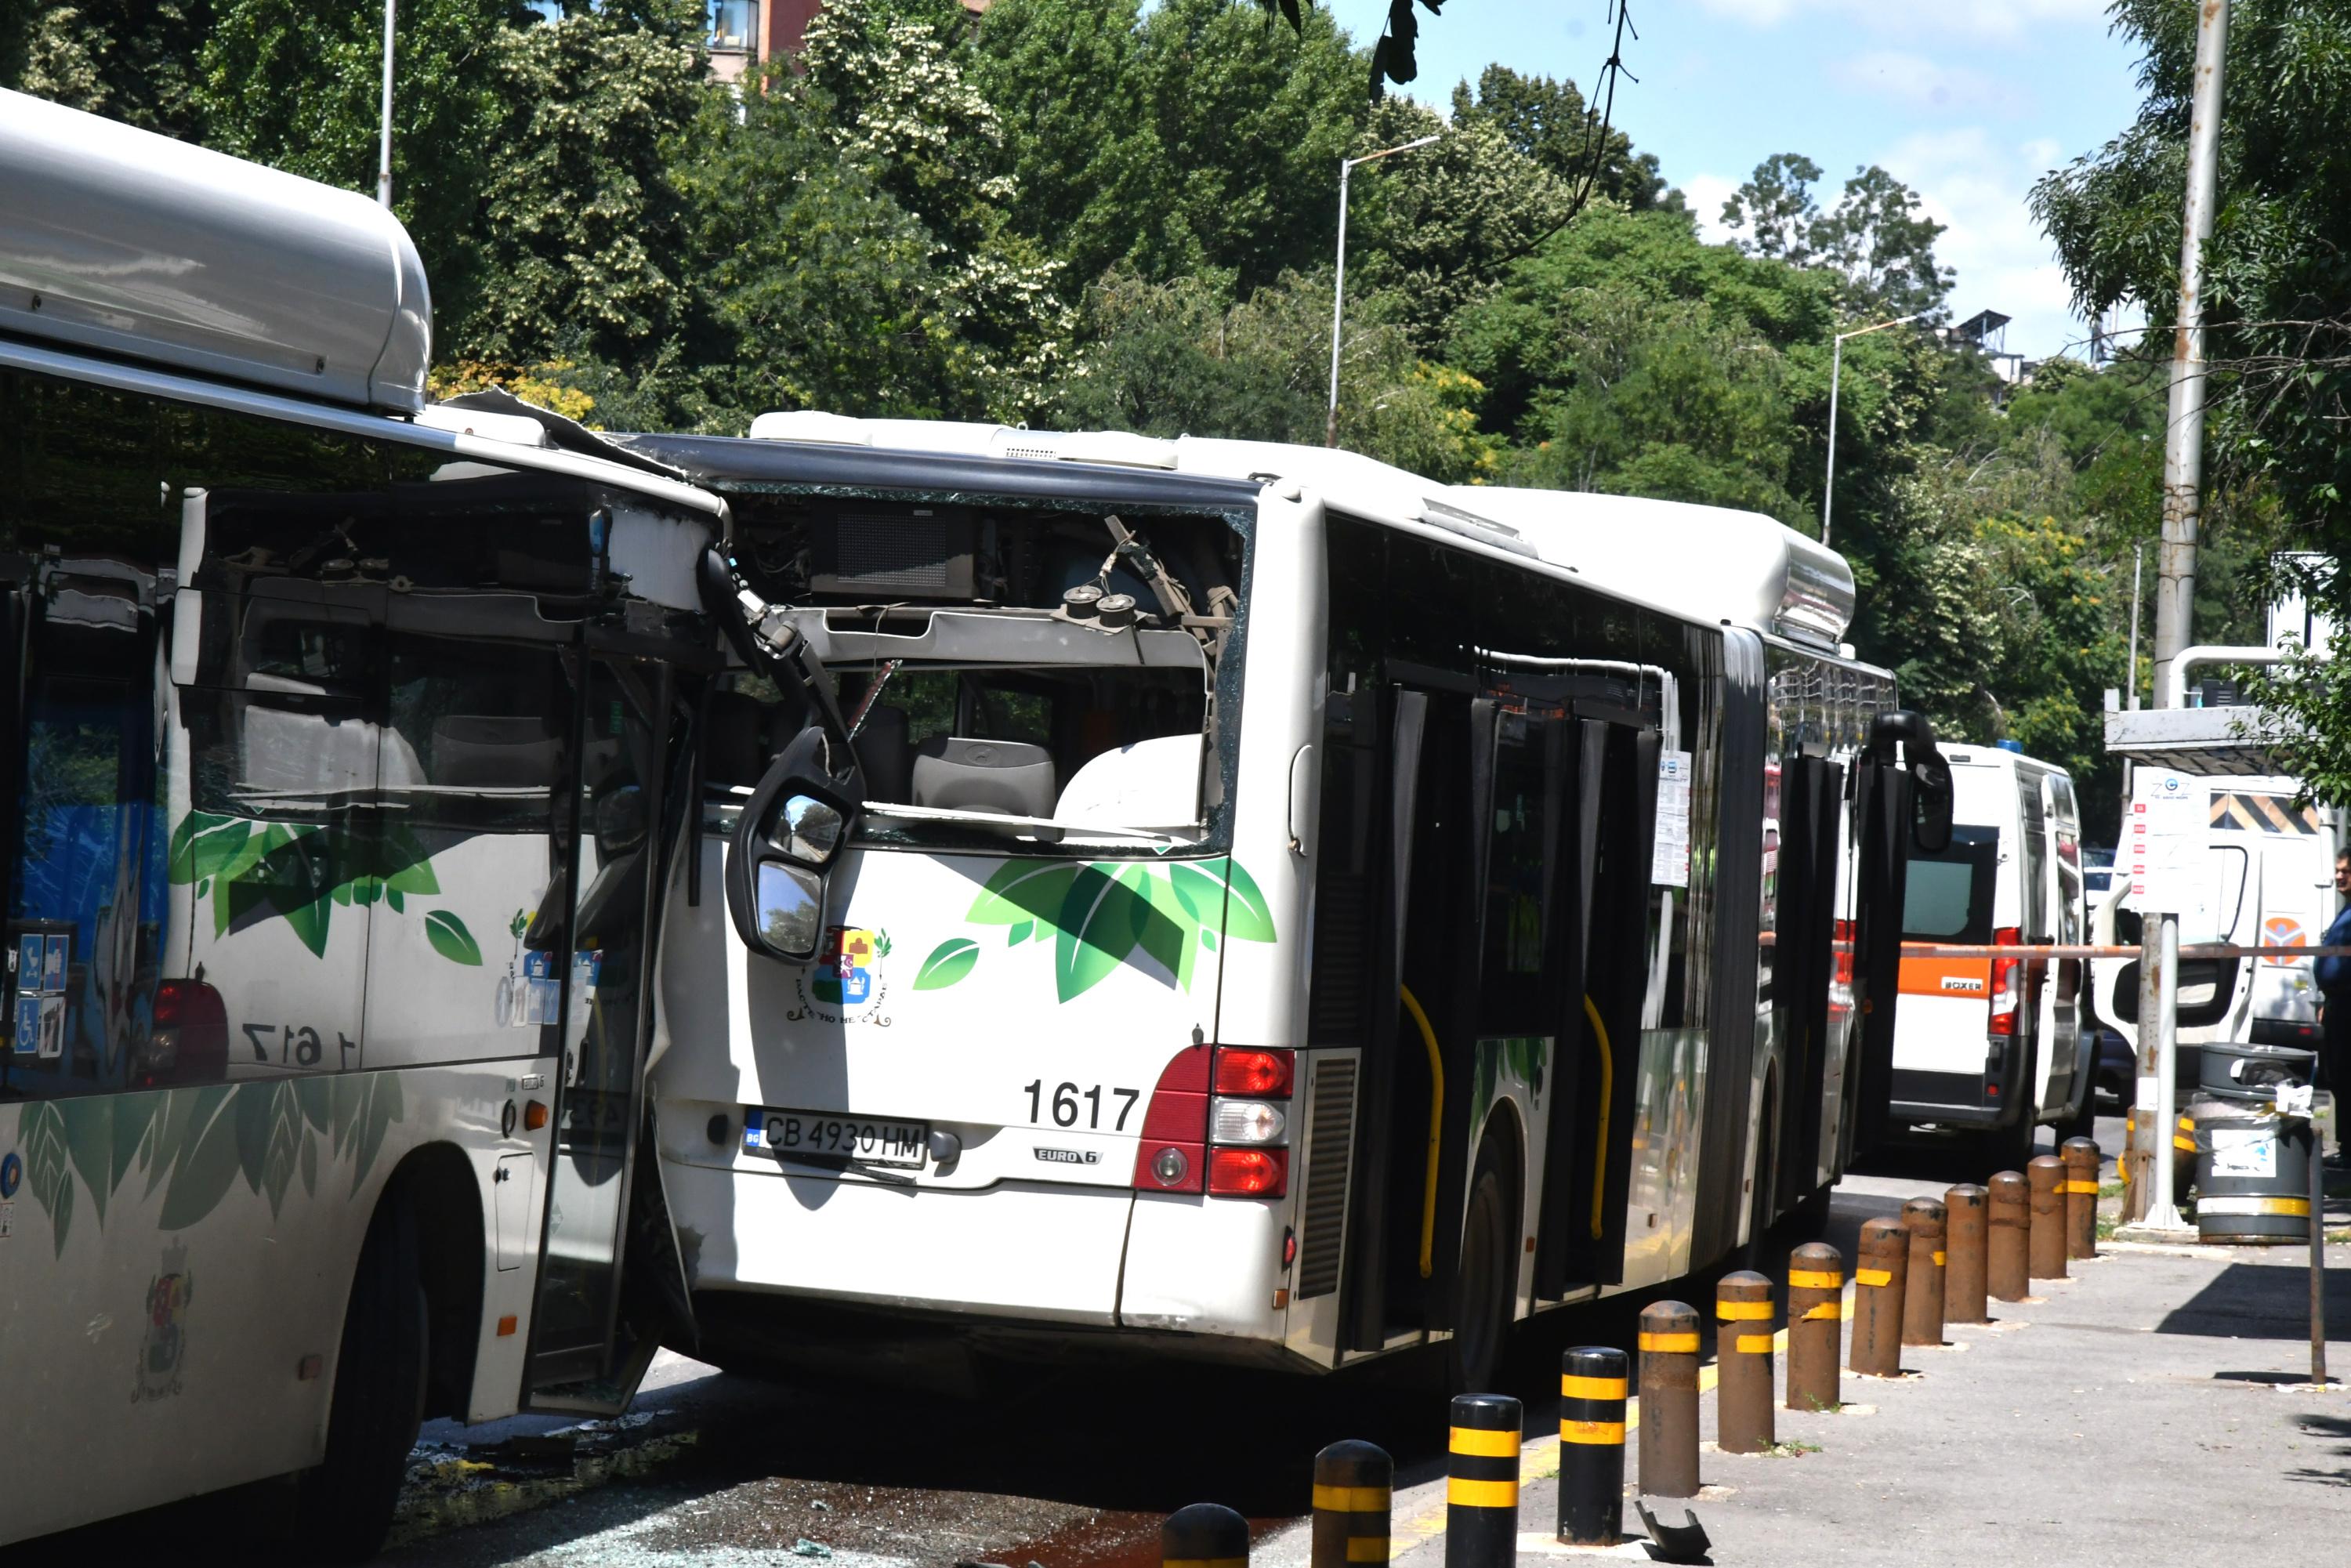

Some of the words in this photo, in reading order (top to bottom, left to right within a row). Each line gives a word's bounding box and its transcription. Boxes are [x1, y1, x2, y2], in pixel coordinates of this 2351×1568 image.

[1945, 982, 1981, 990] BOXER
[1024, 1079, 1139, 1131] 1617
[747, 1132, 759, 1143] BG
[766, 1117, 801, 1146] CB
[809, 1121, 875, 1153] 4930
[882, 1126, 920, 1158] HM
[1038, 1150, 1078, 1162] EURO
[1085, 1151, 1097, 1163] 6
